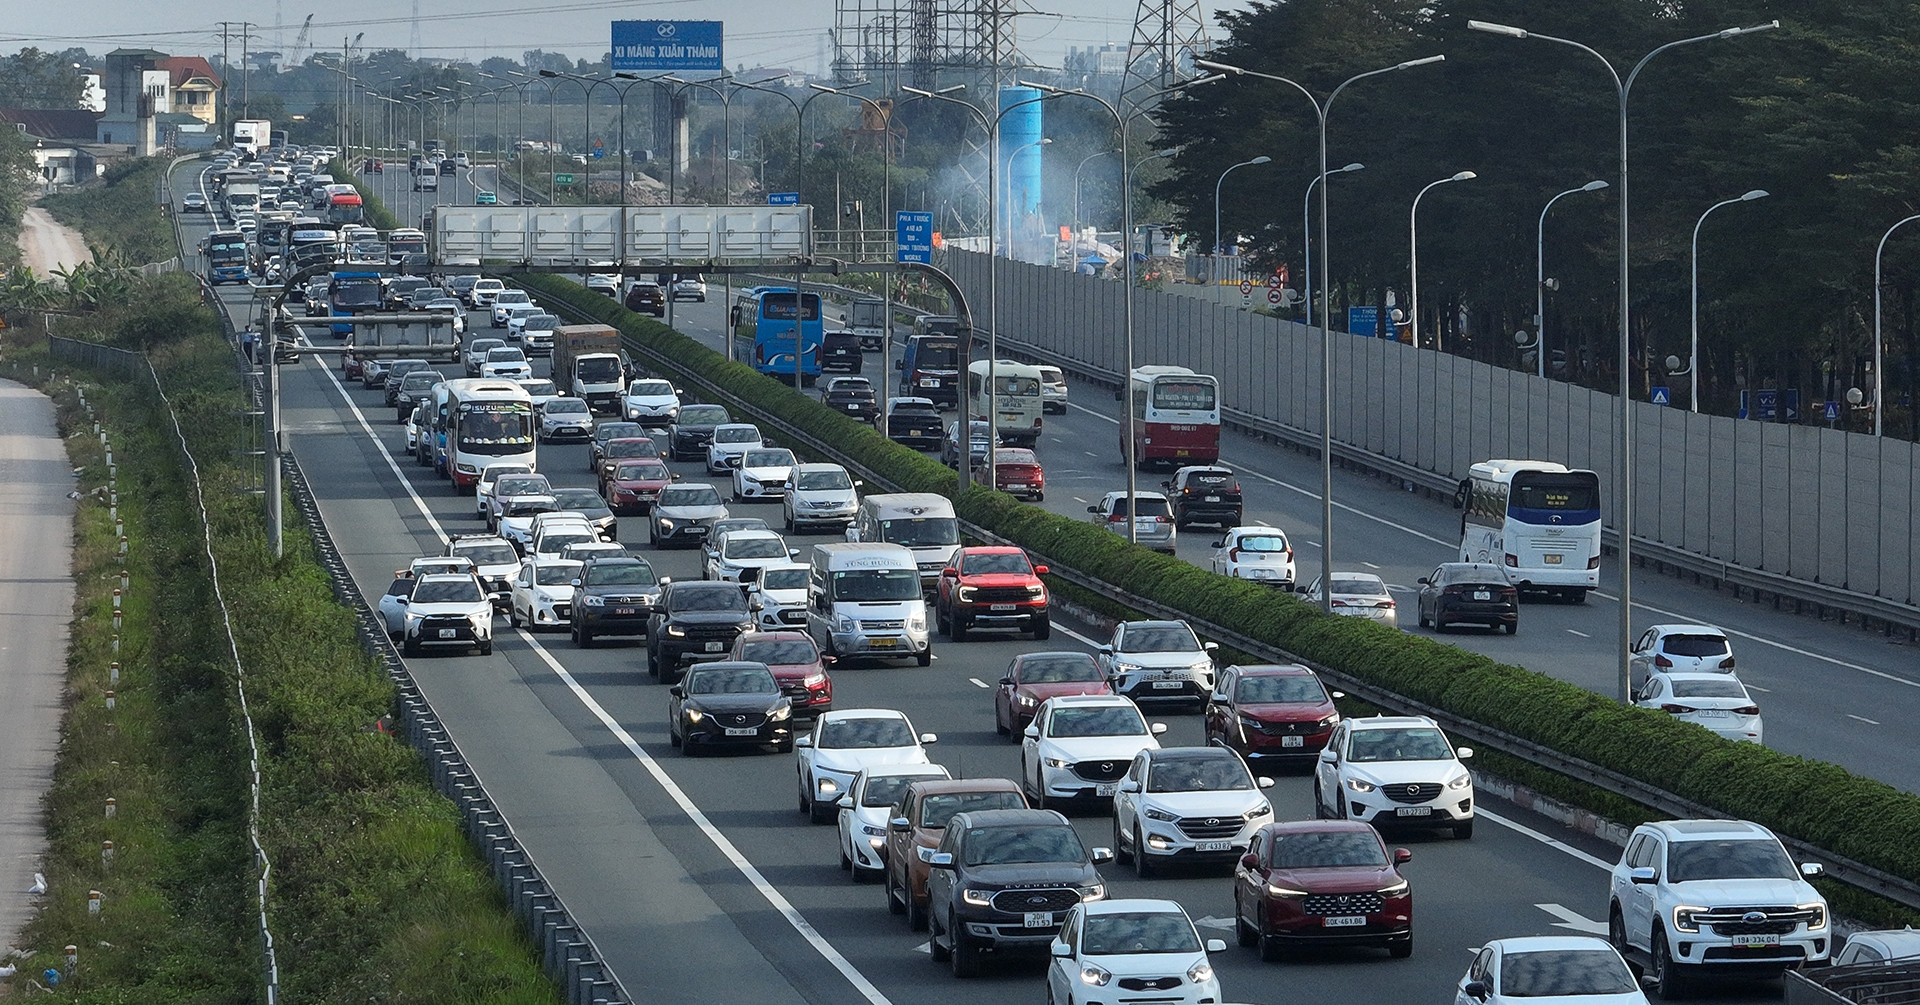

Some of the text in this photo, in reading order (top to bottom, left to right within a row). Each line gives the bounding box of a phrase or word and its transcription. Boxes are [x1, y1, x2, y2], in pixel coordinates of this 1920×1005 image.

[615, 46, 624, 58] XI
[658, 43, 685, 58] XUÂN
[686, 43, 718, 58] THÀNH
